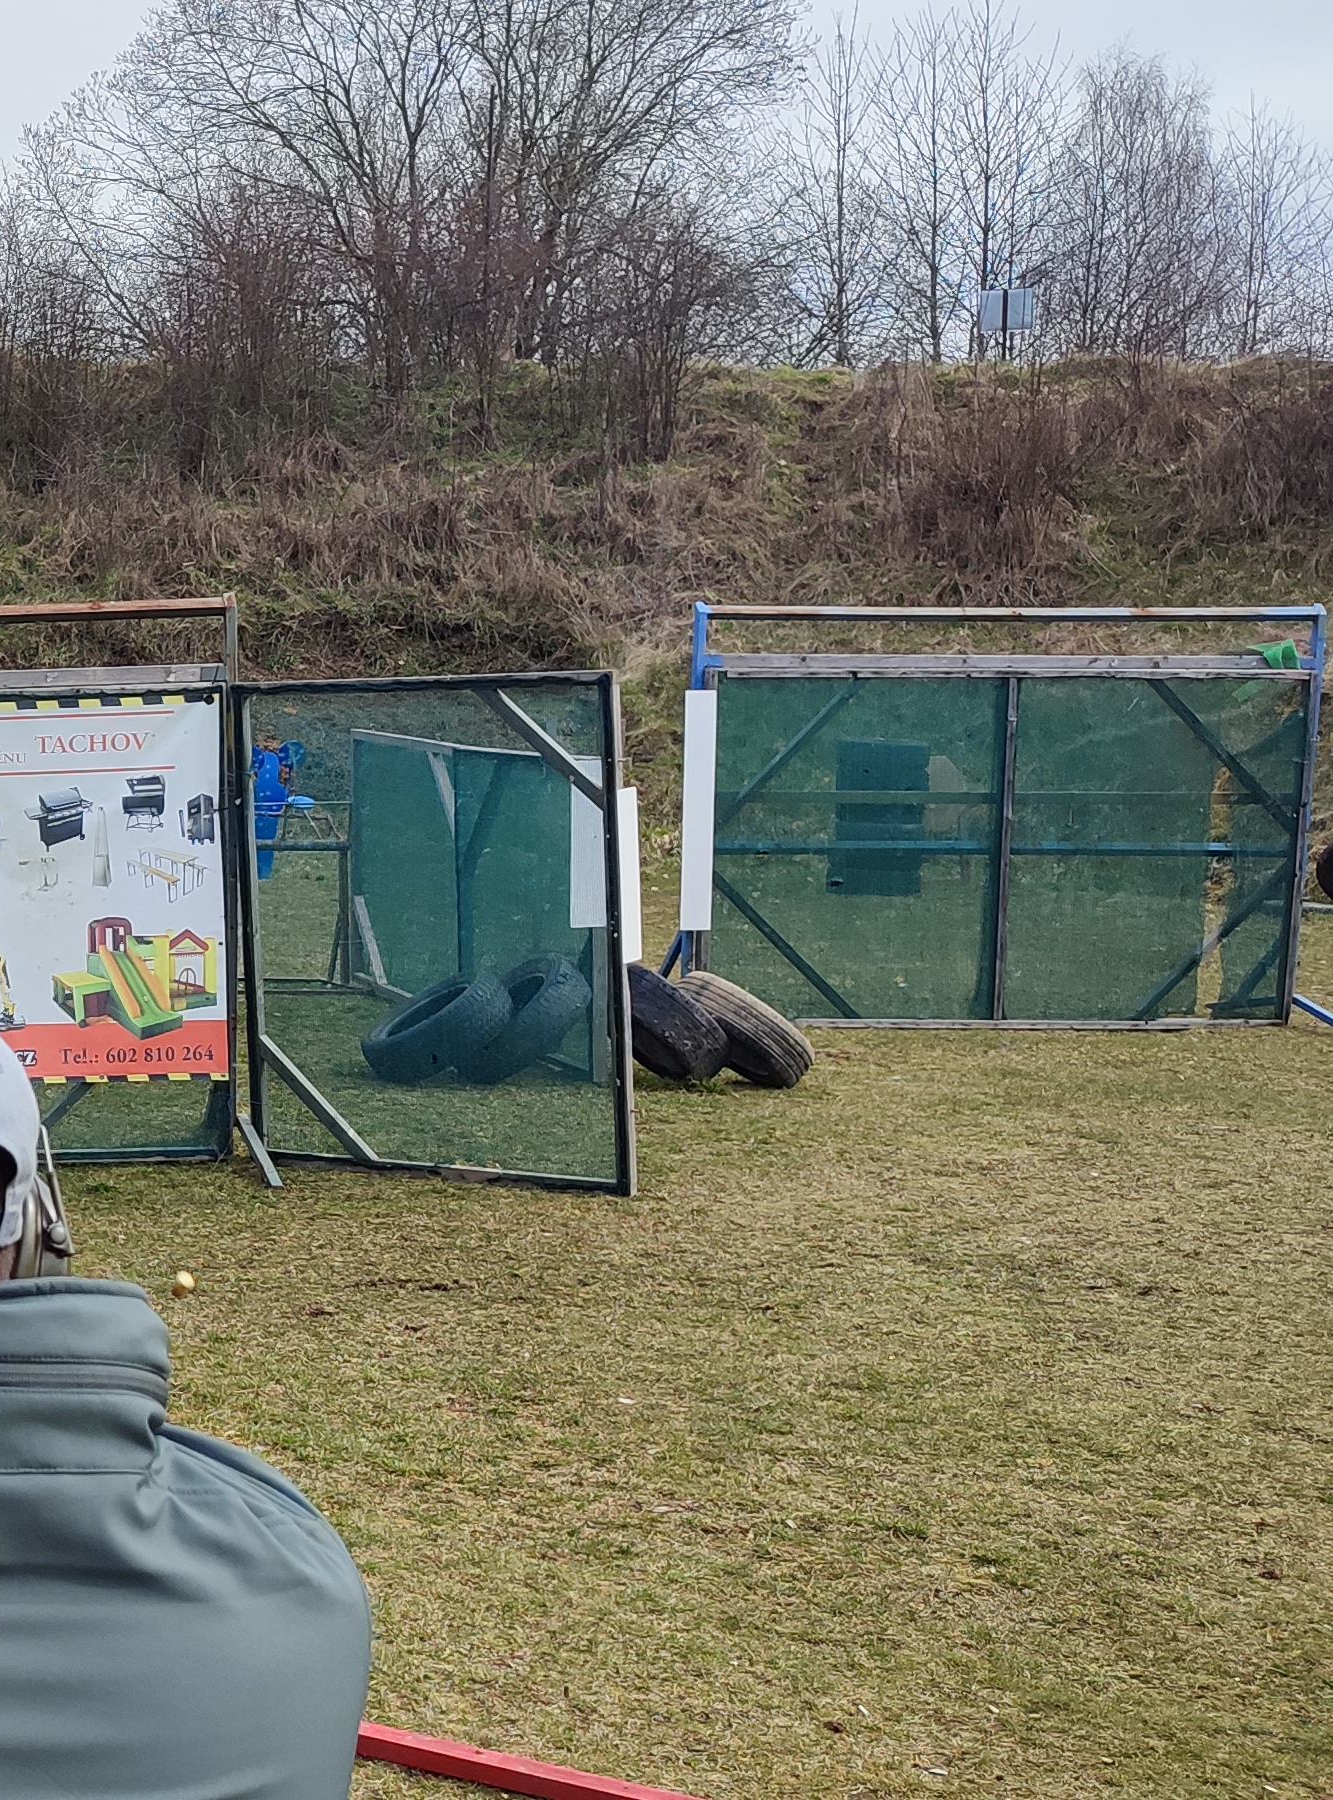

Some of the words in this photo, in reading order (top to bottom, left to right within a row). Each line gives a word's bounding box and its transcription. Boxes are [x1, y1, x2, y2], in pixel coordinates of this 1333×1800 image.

[34, 732, 151, 754] TACHOV
[60, 1048, 100, 1064] Tel.:
[105, 1047, 138, 1063] 602
[144, 1046, 176, 1062] 810
[181, 1044, 214, 1061] 264
